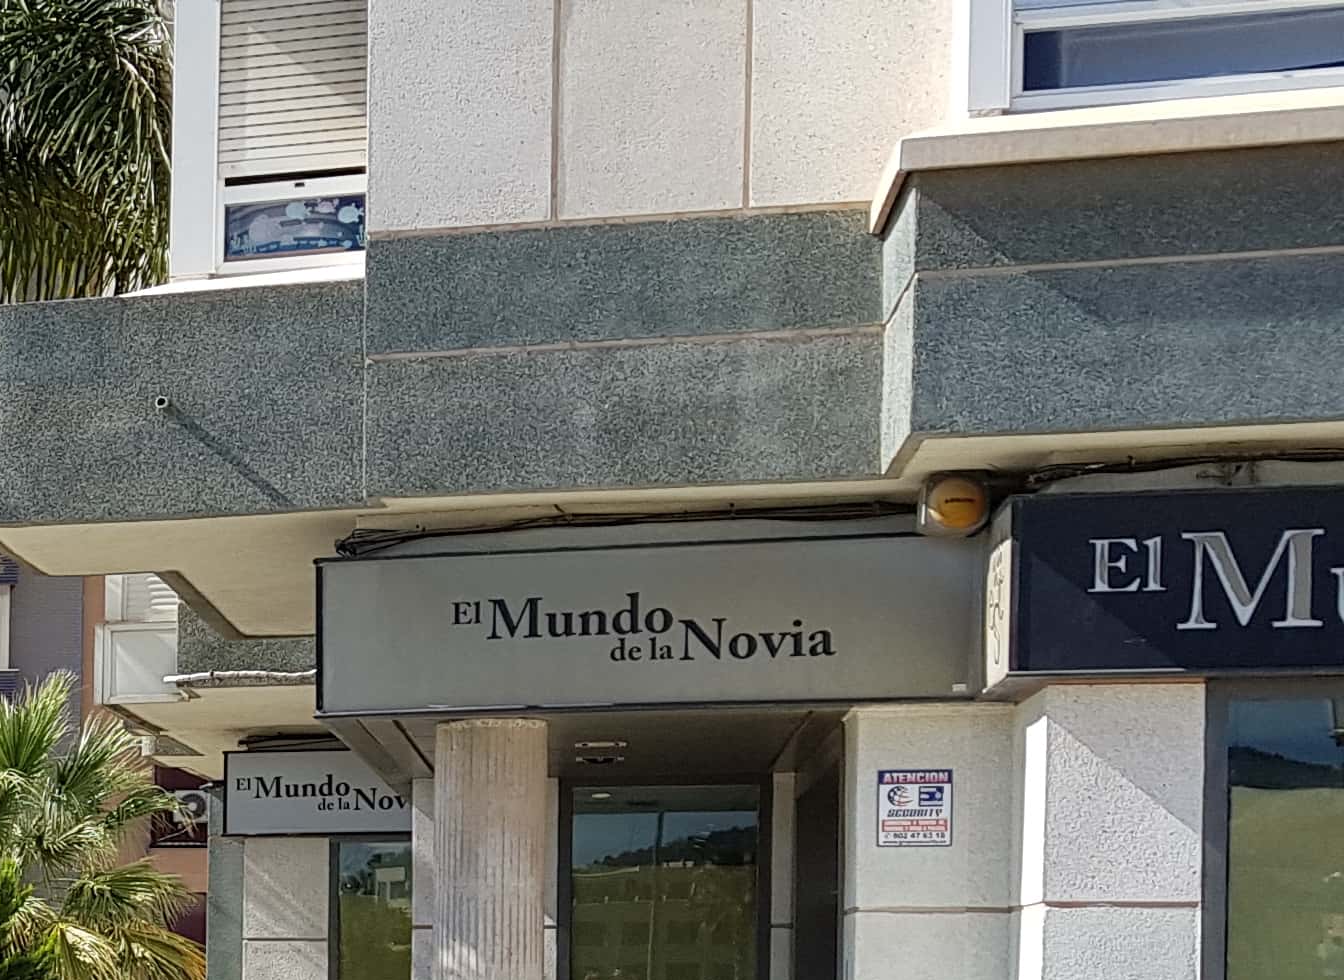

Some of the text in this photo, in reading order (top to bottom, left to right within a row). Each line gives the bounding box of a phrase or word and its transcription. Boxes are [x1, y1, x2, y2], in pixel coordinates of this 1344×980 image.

[1087, 528, 1344, 629] El M
[451, 592, 674, 640] El Mundo
[609, 618, 836, 662] de la Novia
[236, 774, 350, 799] El Mundo
[883, 772, 949, 783] ATENCION
[317, 799, 334, 811] de
[338, 798, 350, 810] la
